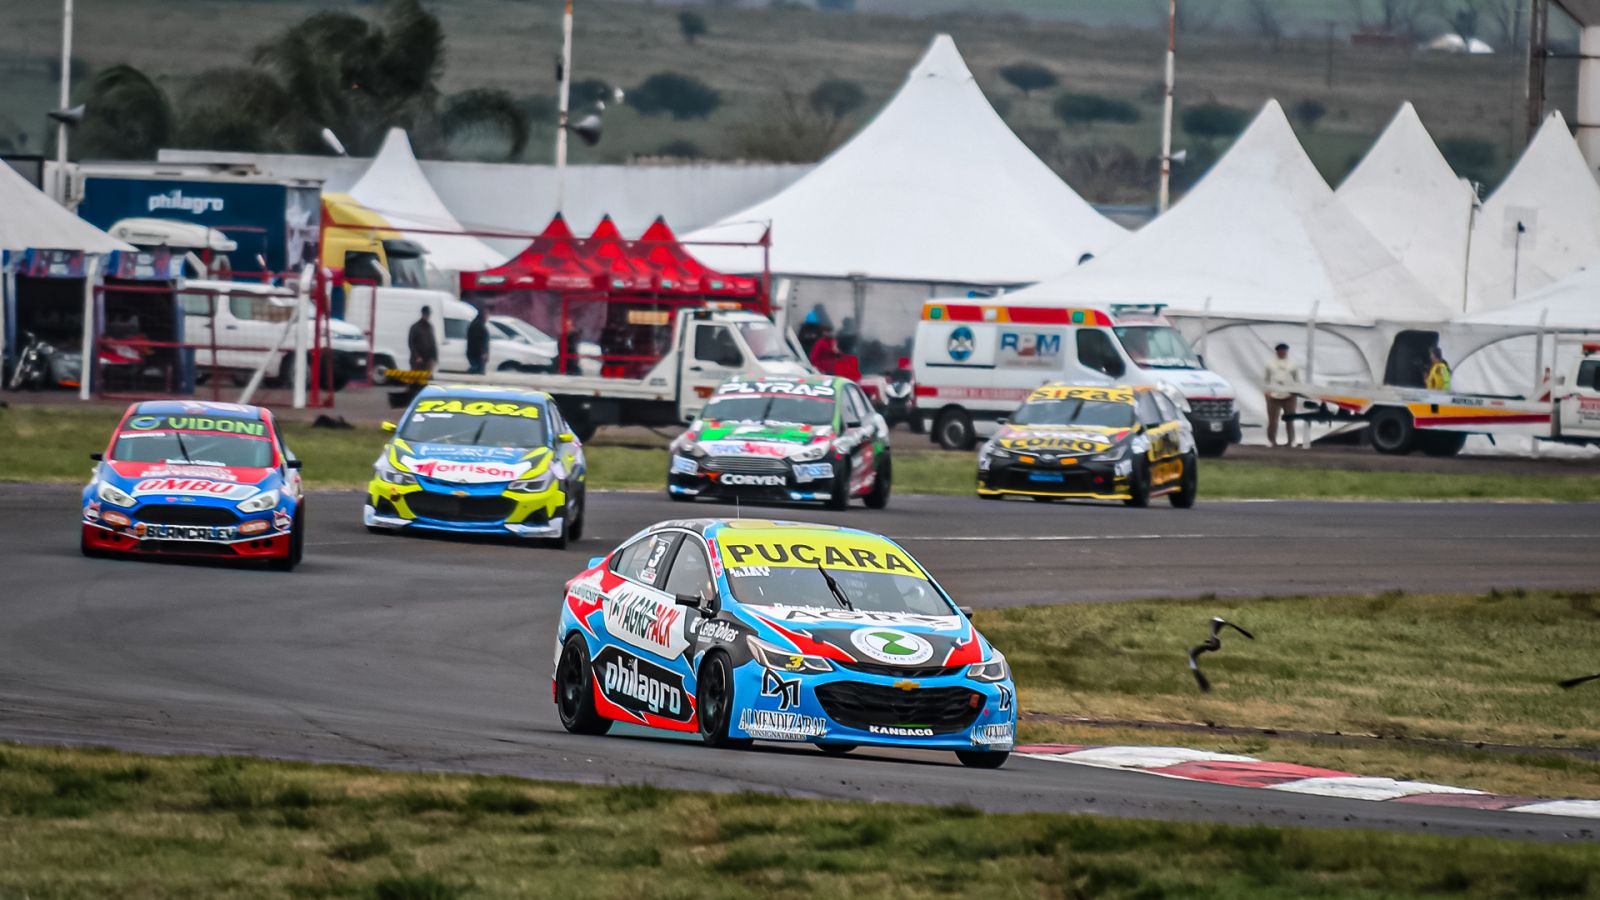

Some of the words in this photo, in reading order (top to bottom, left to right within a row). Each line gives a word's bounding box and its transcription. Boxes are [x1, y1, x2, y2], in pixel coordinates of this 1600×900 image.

[148, 188, 224, 214] philagro
[718, 382, 834, 396] PLYRAP
[167, 416, 265, 436] VIDONI
[720, 473, 787, 487] CORVEN
[726, 543, 916, 574] PUCARA
[785, 656, 804, 668] 3
[605, 655, 682, 715] philagro
